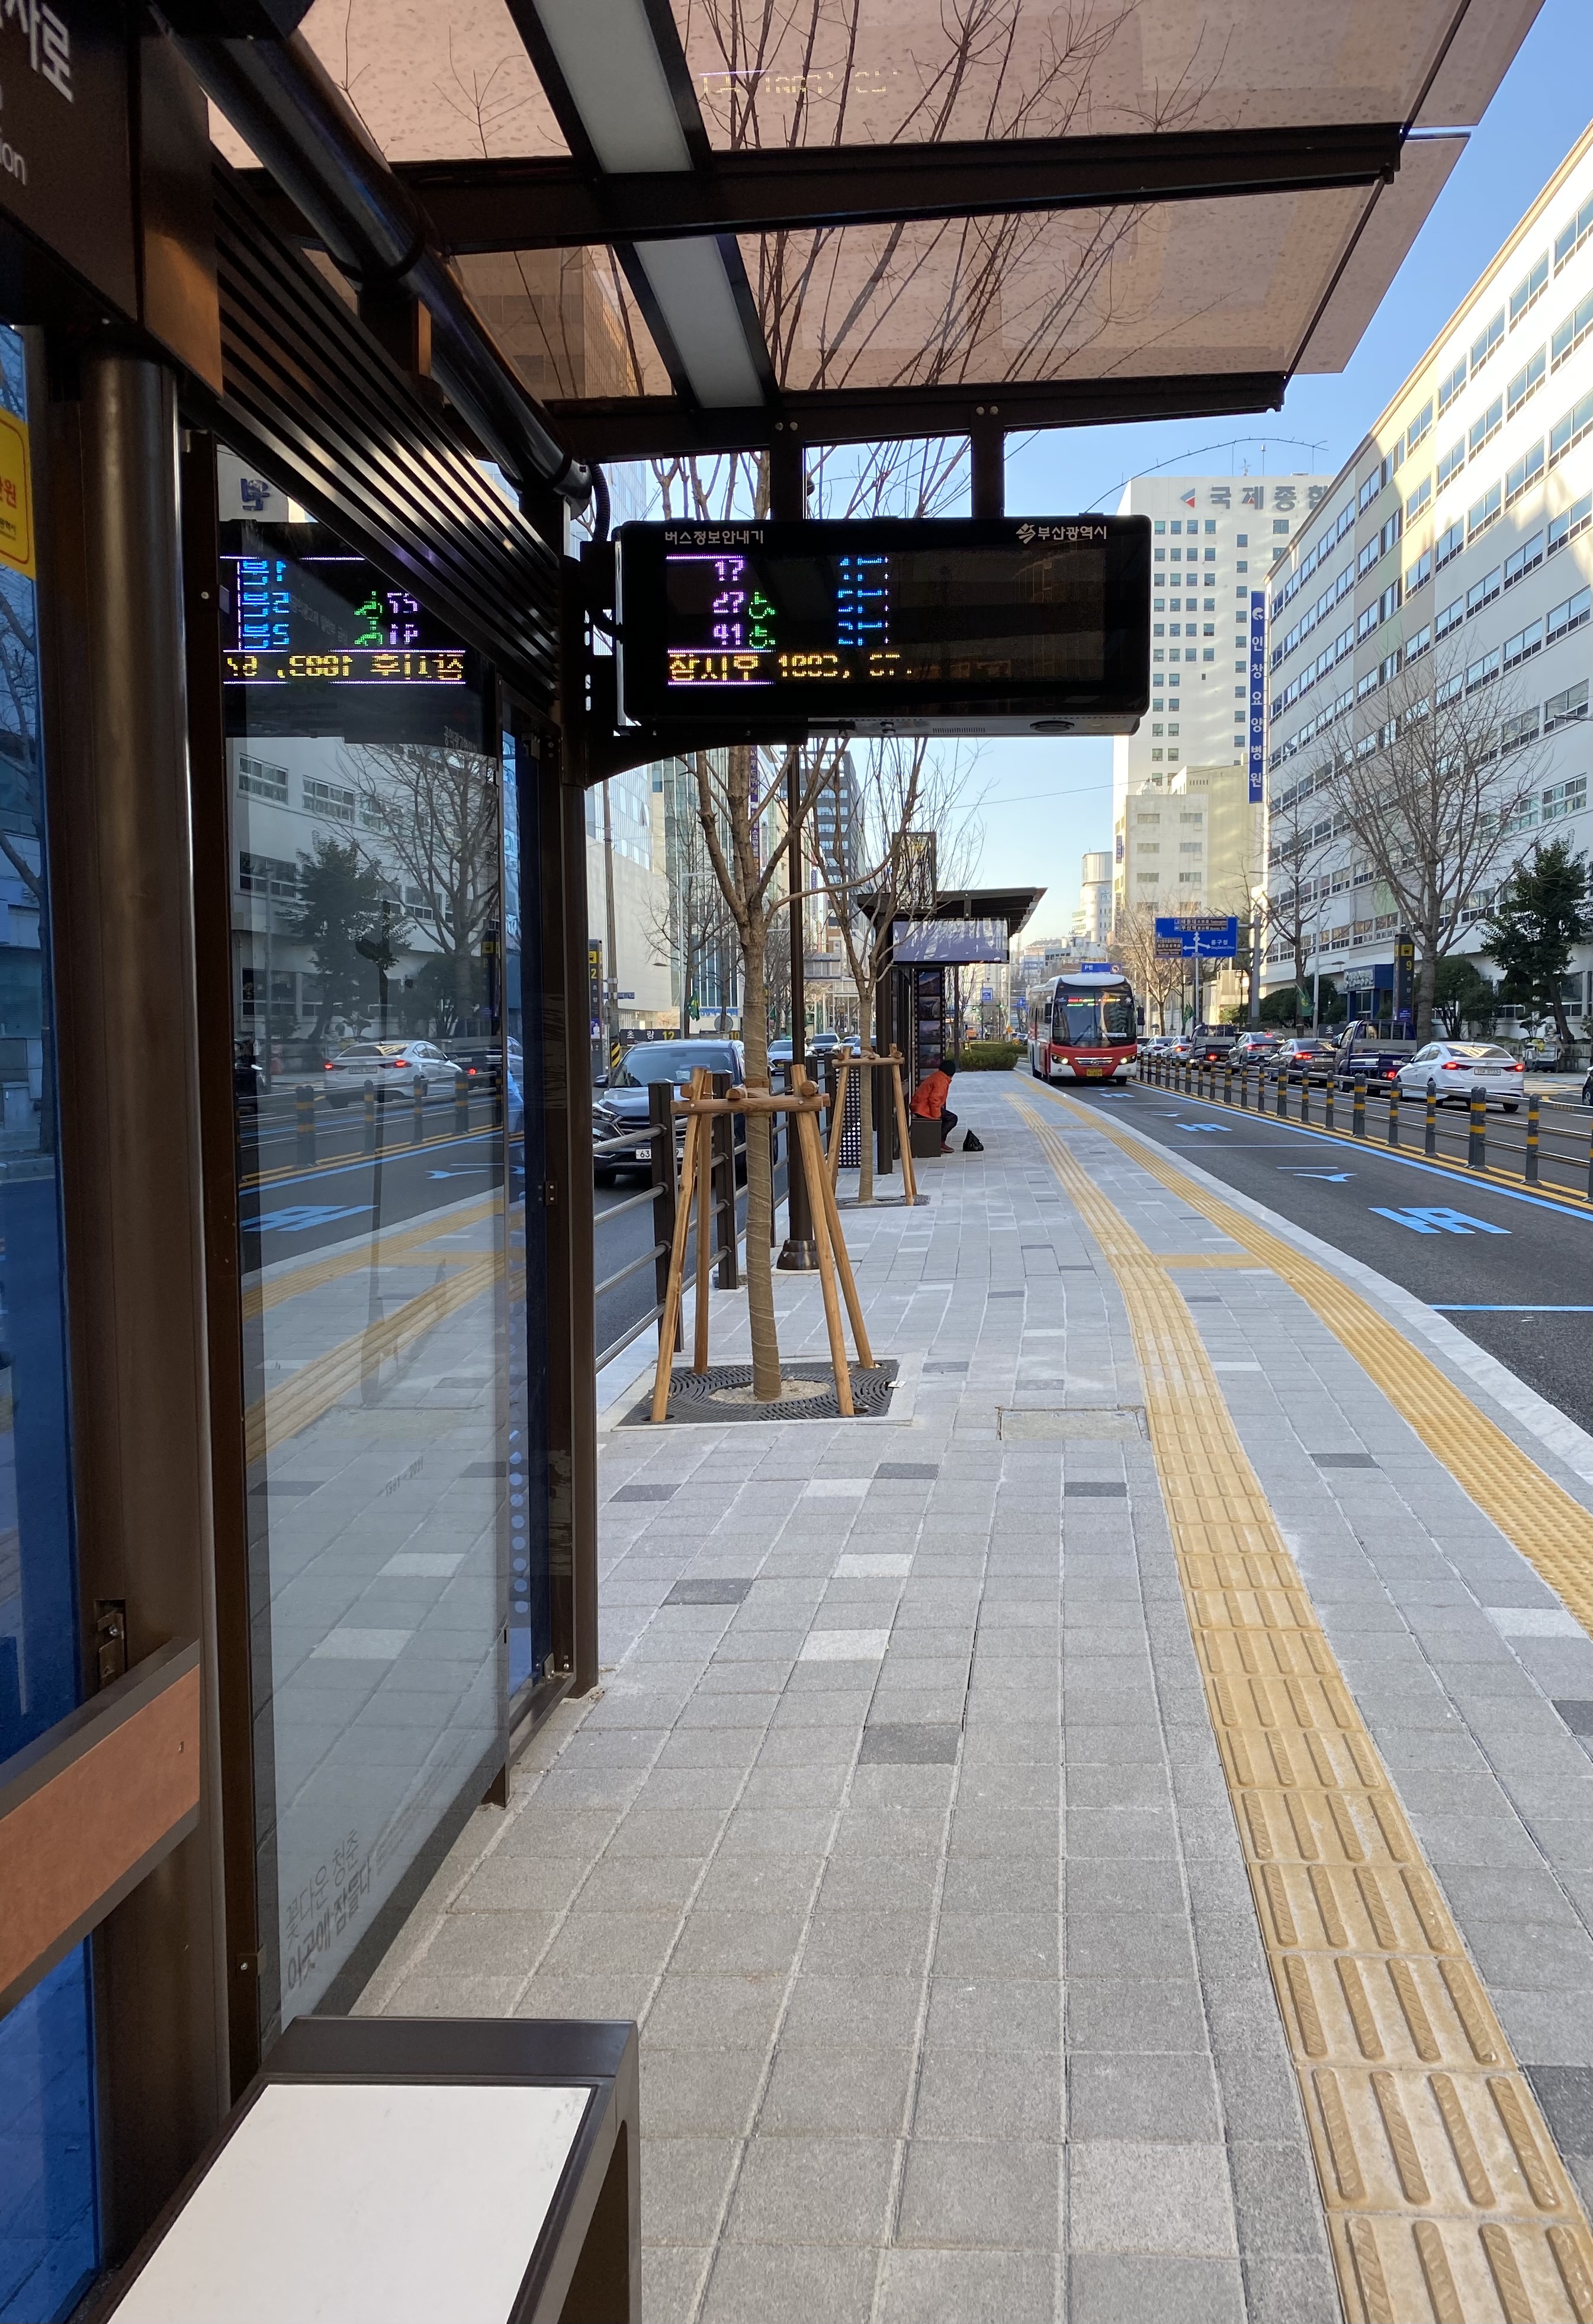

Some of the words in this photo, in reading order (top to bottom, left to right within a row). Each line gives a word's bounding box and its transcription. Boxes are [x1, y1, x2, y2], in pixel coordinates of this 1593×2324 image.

[664, 530, 764, 545] 버스정보안내기
[1038, 525, 1107, 541] 부산광역시
[715, 559, 744, 581] 17
[712, 591, 744, 613] 27
[712, 623, 742, 645] 41
[1250, 636, 1263, 788] 인창요양병원
[1406, 960, 1412, 971] 9
[662, 1030, 676, 1040] 12
[285, 1865, 329, 1950] 꽃다운
[333, 1828, 359, 1887] 청춘
[287, 1906, 331, 1991] 이곳에
[333, 1856, 372, 1937] 잠들다
